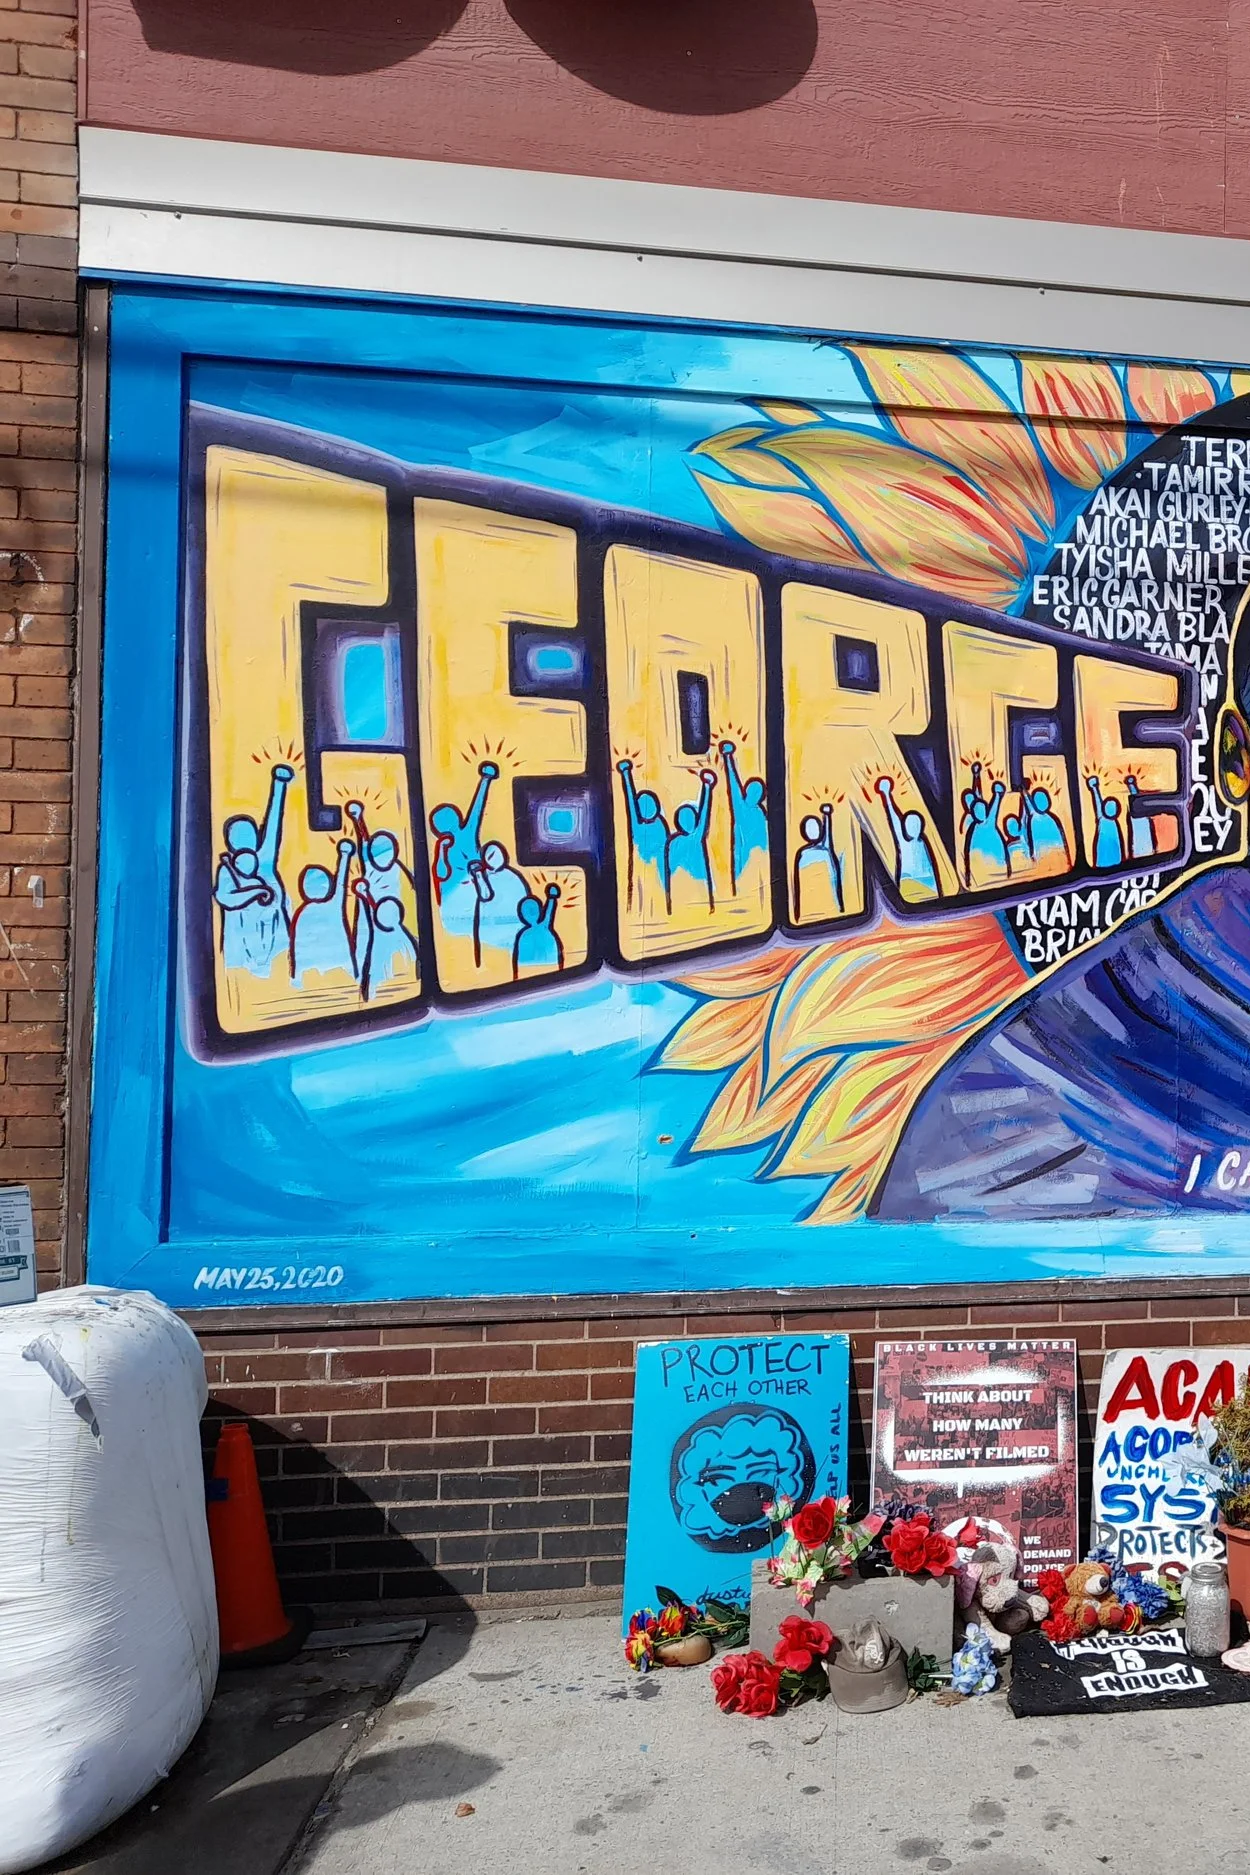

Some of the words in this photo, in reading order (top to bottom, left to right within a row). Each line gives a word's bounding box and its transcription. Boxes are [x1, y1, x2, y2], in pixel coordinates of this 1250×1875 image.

[1144, 462, 1233, 498] TAMIR
[1089, 486, 1151, 518] AKAI
[1157, 490, 1244, 525] GURLEY
[1076, 515, 1200, 550] MICHAEL
[1054, 543, 1155, 581] TYISHA
[1033, 574, 1098, 607] ERIC
[1101, 578, 1225, 615] GARNER
[1053, 605, 1171, 641] SANDRA
[1177, 611, 1230, 644] BLA
[196, 436, 1190, 1040] GEORGE
[1184, 1153, 1202, 1194] I
[884, 1343, 937, 1354] BLACK
[947, 1342, 997, 1353] LIVES
[1007, 1341, 1071, 1351] MATTER
[661, 1341, 830, 1387] PROTECT
[683, 1381, 738, 1403] EACH
[747, 1378, 812, 1396] OTHER
[923, 1391, 974, 1404] THINK
[977, 1389, 1033, 1403] ABOUT
[829, 1402, 842, 1436] ALL
[932, 1419, 972, 1432] HOW
[975, 1417, 1023, 1431] MANY
[829, 1443, 840, 1465] US
[904, 1447, 983, 1462] WEREN'T
[985, 1445, 1050, 1460] FILMED
[826, 1471, 839, 1500] ELP
[1023, 1536, 1041, 1545] WE
[1023, 1549, 1072, 1559] DEMAND
[1111, 1649, 1147, 1673] IS
[1090, 1666, 1198, 1692] ENOUGH
